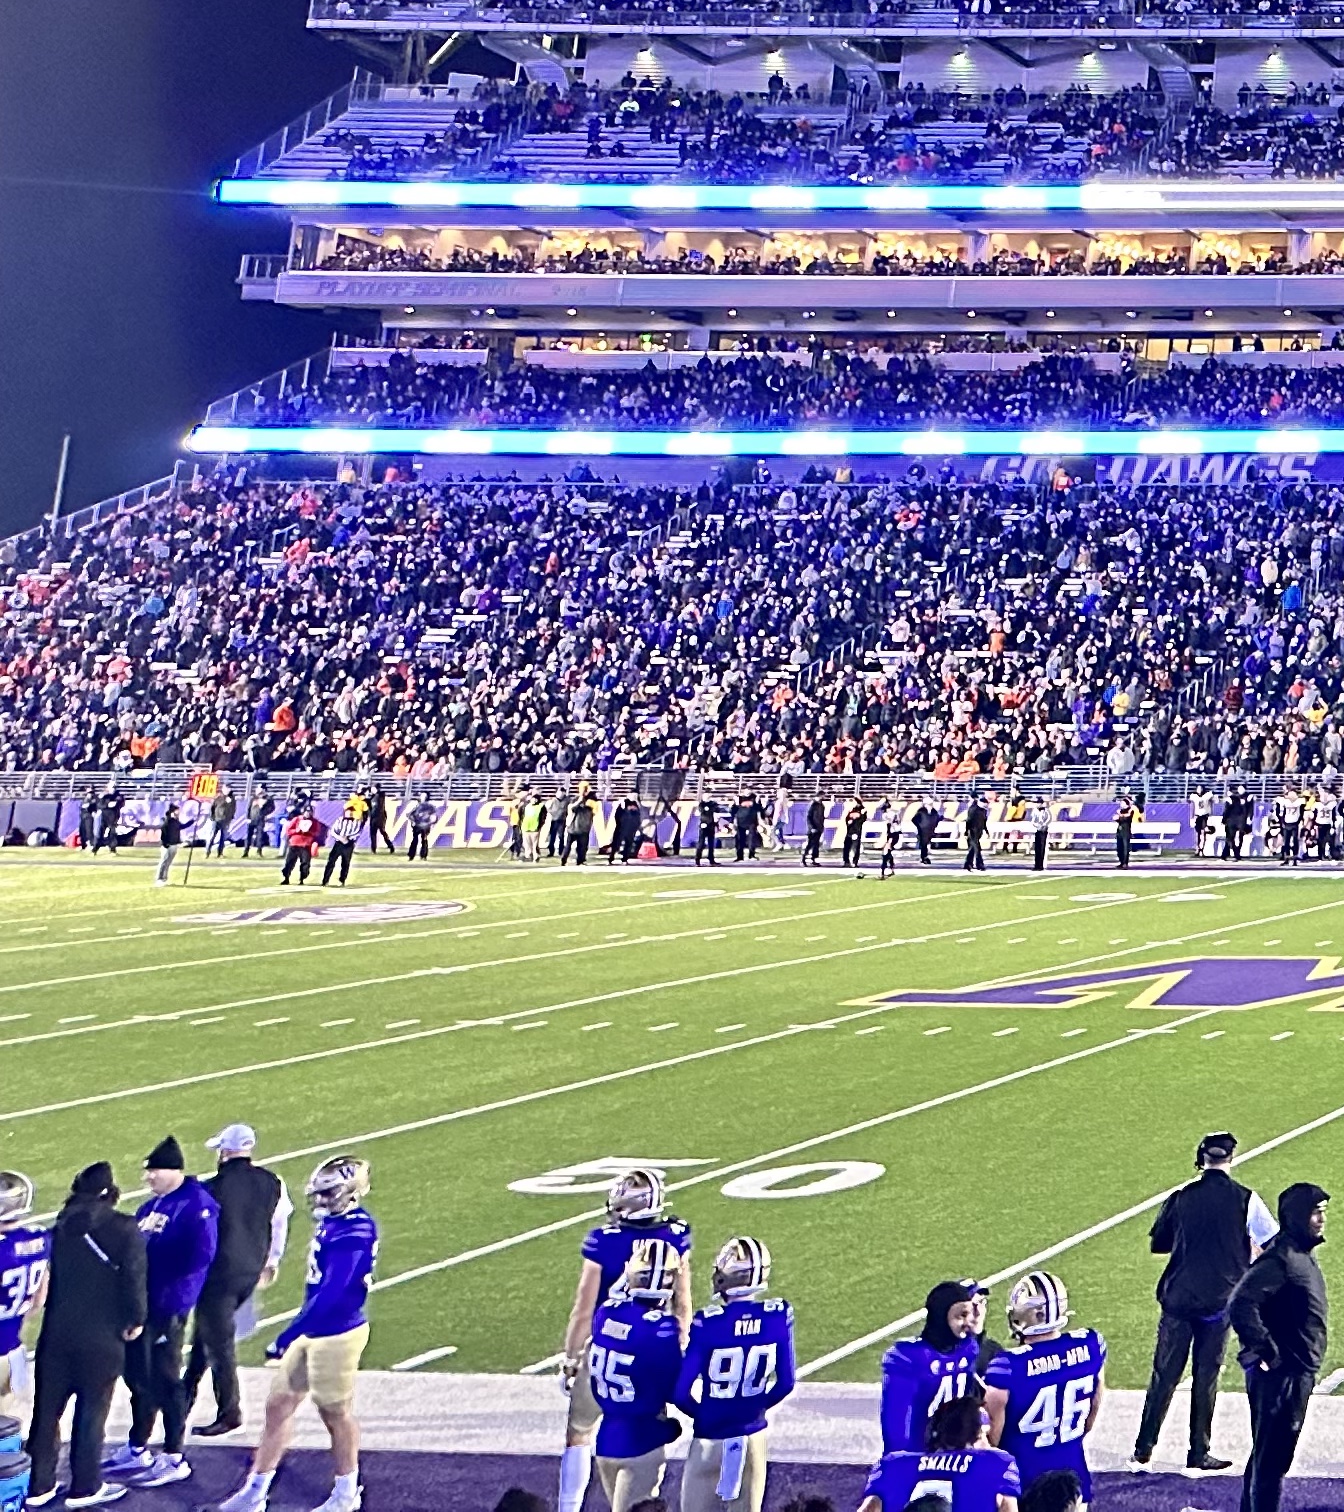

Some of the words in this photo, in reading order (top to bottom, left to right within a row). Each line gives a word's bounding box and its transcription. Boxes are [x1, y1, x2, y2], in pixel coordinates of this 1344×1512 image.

[1110, 455, 1316, 484] DAWGS
[709, 1344, 778, 1399] 90
[1019, 1378, 1094, 1448] 46
[918, 1453, 973, 1473] SMALLS
